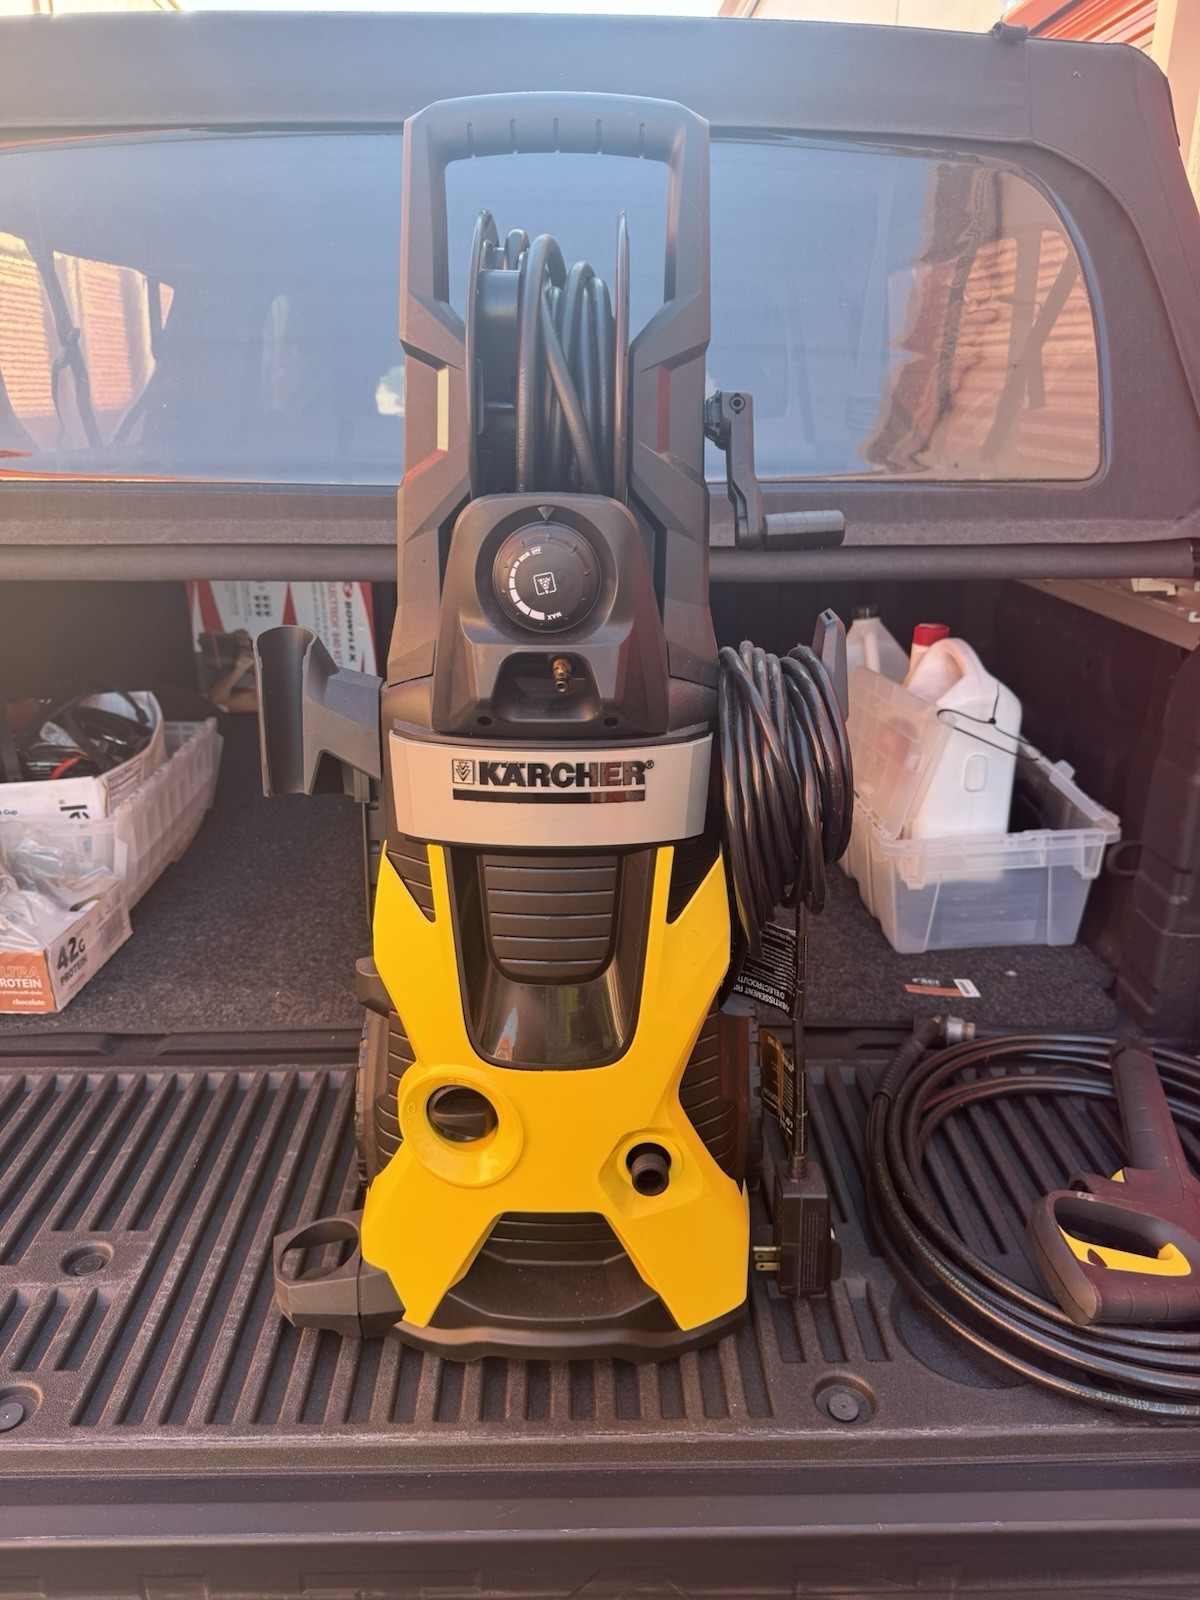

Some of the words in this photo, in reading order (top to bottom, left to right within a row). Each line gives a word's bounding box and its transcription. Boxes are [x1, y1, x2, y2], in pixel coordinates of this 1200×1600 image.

[518, 551, 531, 562] MIN
[547, 611, 562, 621] MAX
[345, 600, 356, 662] BOWFLEX
[57, 937, 86, 970] 42G
[0, 965, 40, 978] LTRA
[60, 954, 88, 986] PROTEIN
[0, 978, 42, 989] ROTEIN
[12, 998, 46, 1006] chocolate
